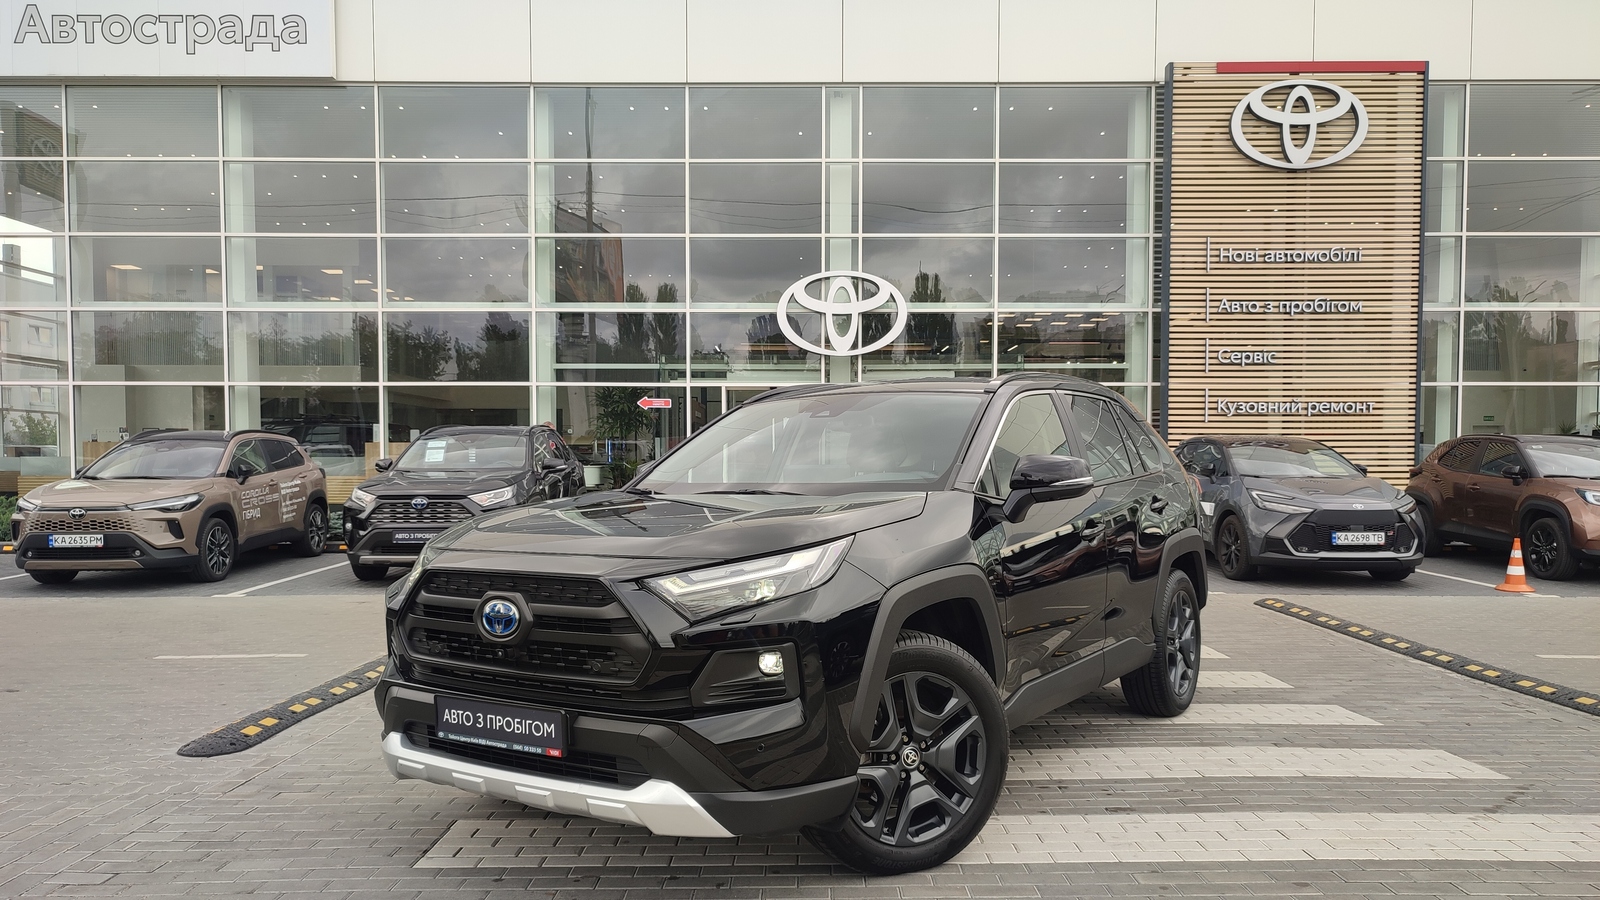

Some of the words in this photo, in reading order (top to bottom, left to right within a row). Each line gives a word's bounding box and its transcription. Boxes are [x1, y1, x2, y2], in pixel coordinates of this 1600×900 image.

[13, 4, 308, 55] Автострада
[1218, 247, 1259, 262] Нові
[1264, 246, 1363, 262] автомобілі
[1217, 298, 1260, 313] Авто
[1264, 300, 1273, 313] з
[1279, 298, 1363, 316] пробігом
[1217, 348, 1277, 367] Сервіс
[1216, 398, 1302, 417] Кузовний
[1307, 401, 1376, 417] ремонт
[240, 486, 270, 499] COROLLA
[241, 493, 280, 508] CROSS
[242, 507, 261, 520] ГІБРИД
[68, 536, 88, 545] 2635
[1350, 534, 1371, 542] 2698
[443, 708, 474, 726] АВТО
[476, 713, 484, 728] З
[486, 714, 555, 738] ПРОБІГОМ
